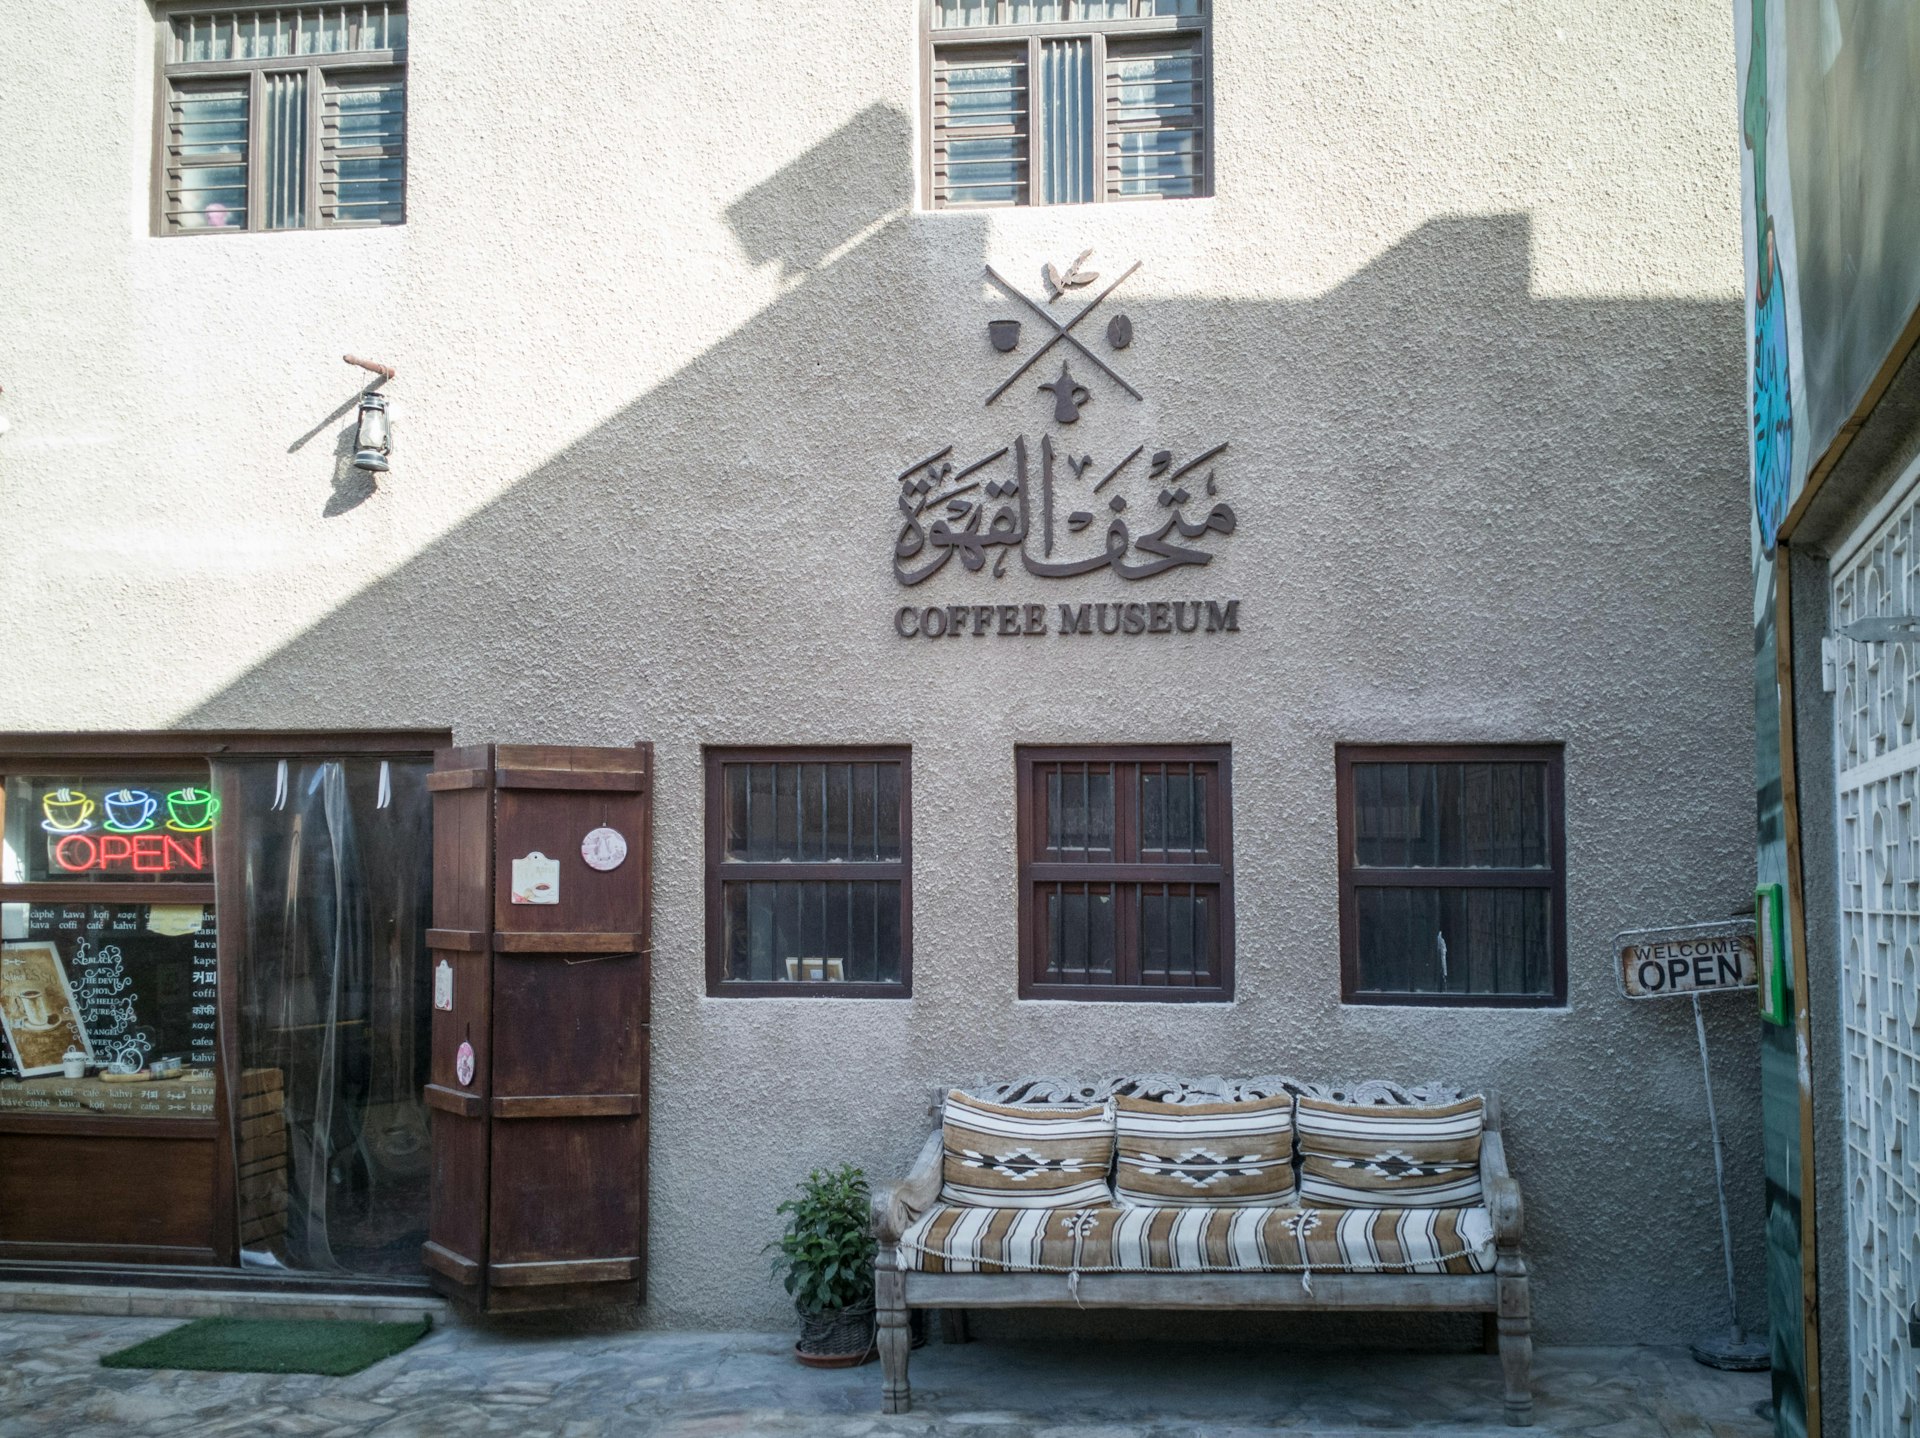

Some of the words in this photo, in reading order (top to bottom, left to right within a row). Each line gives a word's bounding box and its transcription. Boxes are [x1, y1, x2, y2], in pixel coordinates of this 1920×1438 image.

[894, 603, 1047, 638] COFFEE
[1058, 599, 1241, 636] MUSEUM
[56, 833, 202, 872] OPEN
[62, 910, 85, 919] kawa
[30, 921, 50, 929] kava
[58, 920, 78, 929] coffi
[112, 921, 137, 930] kahvi
[193, 939, 217, 949] kava
[1633, 940, 1741, 961] WELCOME
[193, 956, 217, 967] kape
[1637, 953, 1743, 992] OPEN
[192, 971, 217, 985] 커피
[192, 988, 216, 998] coffi
[93, 1028, 119, 1036] ANGEL
[191, 1036, 214, 1046] cafea
[191, 1052, 216, 1062] kahvi
[109, 1088, 133, 1098] kahvi
[191, 1085, 214, 1095] kava
[59, 1099, 80, 1108] kawa
[190, 1102, 214, 1114] kape
